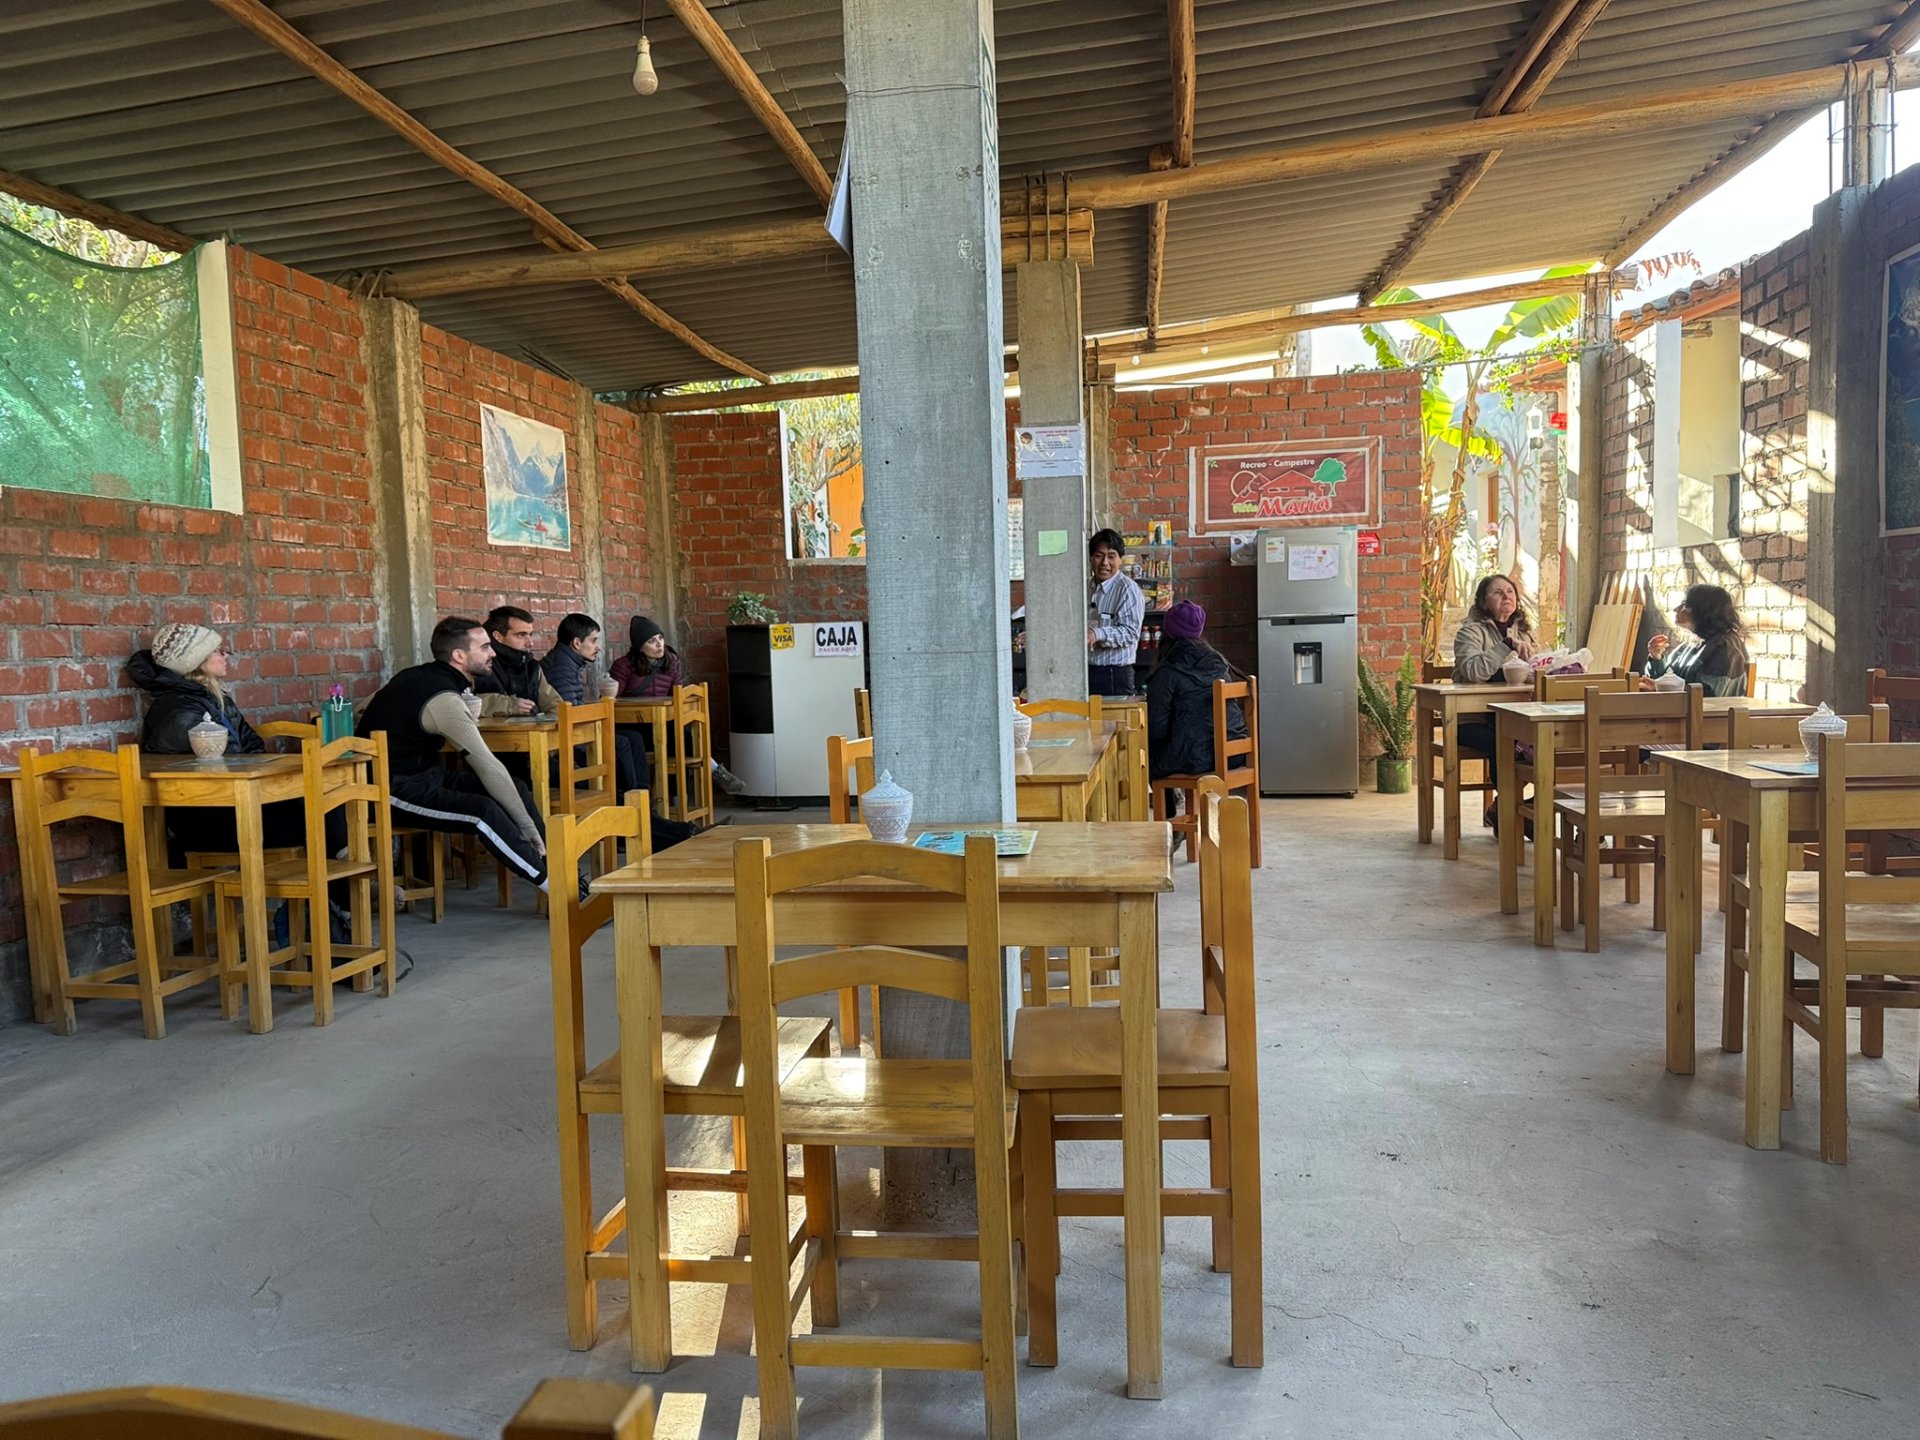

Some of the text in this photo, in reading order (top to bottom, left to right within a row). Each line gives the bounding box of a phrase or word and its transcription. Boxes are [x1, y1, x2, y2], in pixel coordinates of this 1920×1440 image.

[1240, 461, 1267, 469] Recreo
[1273, 458, 1315, 468] Campestre
[773, 635, 793, 643] VISA
[816, 626, 858, 647] CAJA
